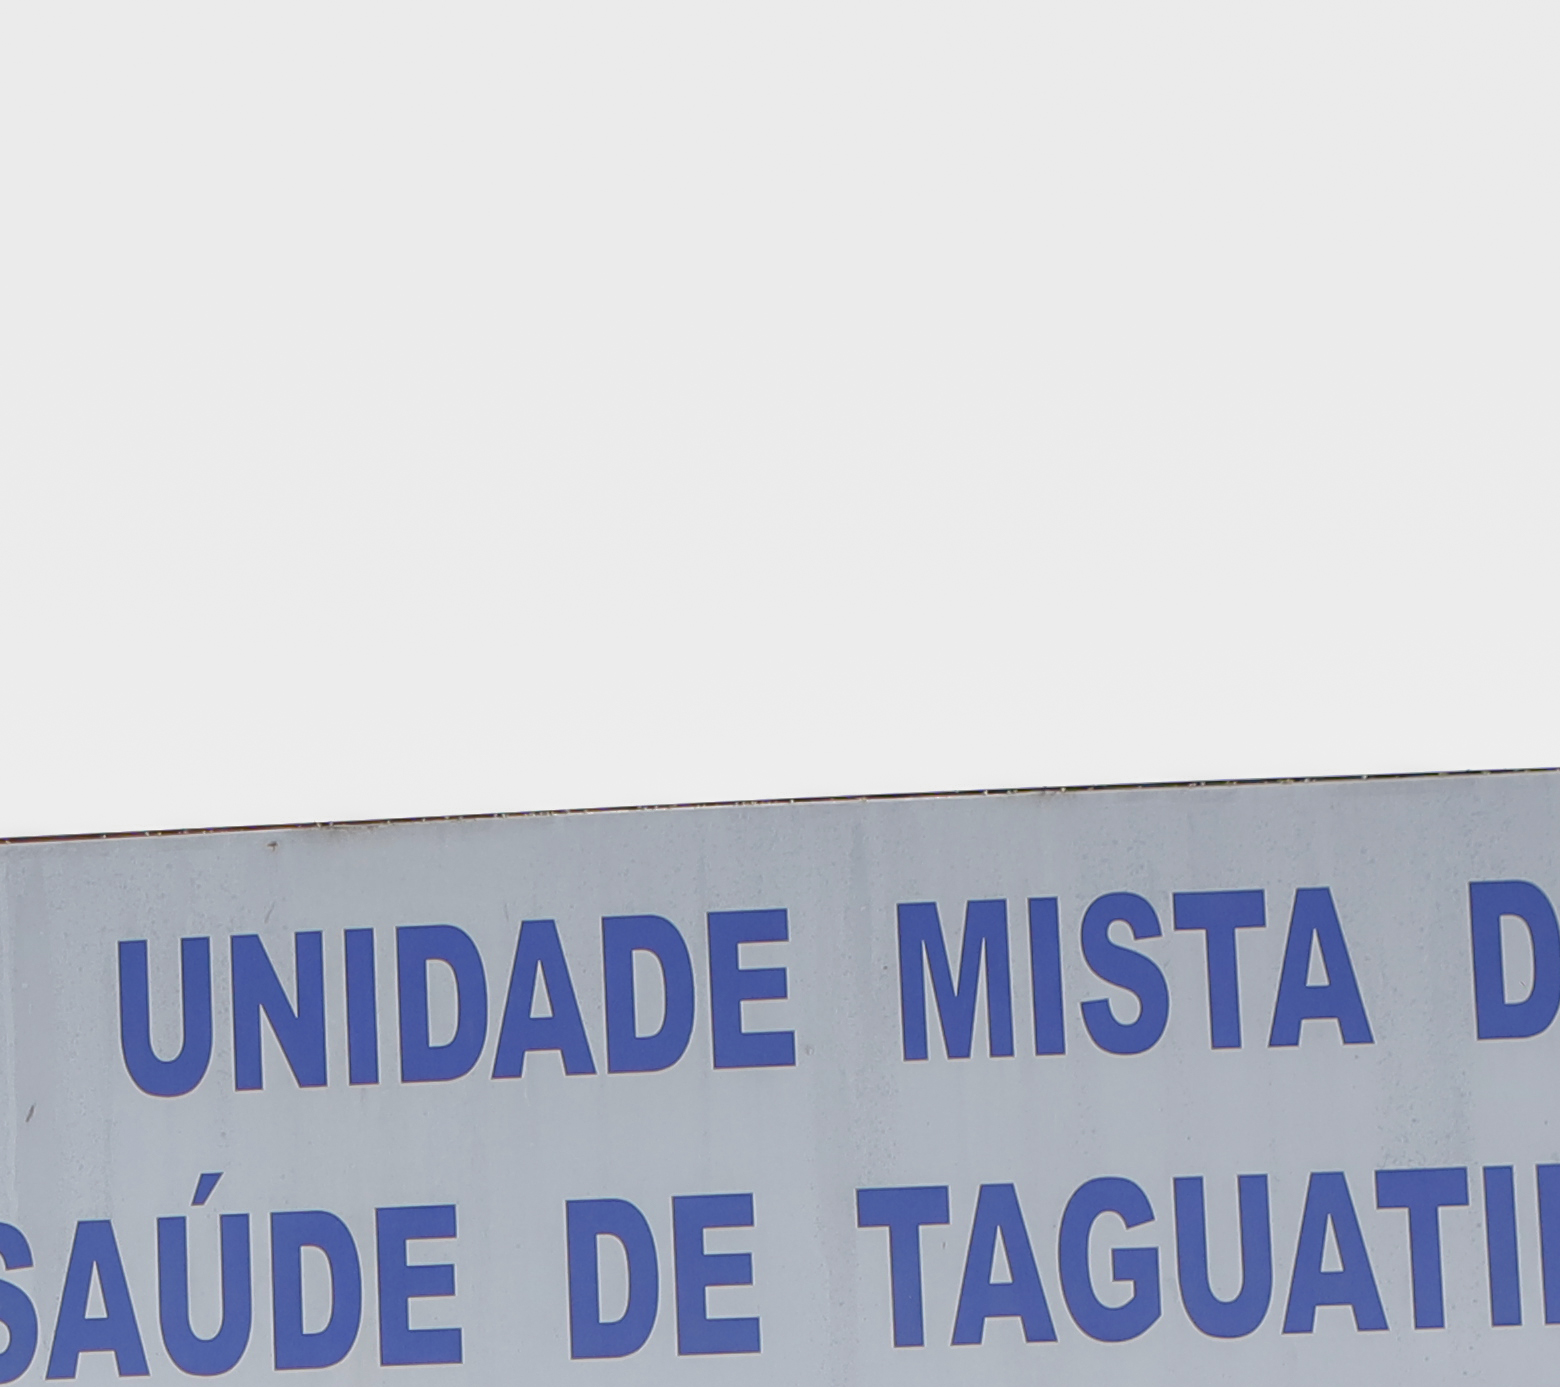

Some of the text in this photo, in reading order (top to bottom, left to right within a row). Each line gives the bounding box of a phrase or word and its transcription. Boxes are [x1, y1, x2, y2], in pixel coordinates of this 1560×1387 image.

[118, 907, 797, 1097] UNIDADE
[897, 887, 1375, 1061] MISTA
[566, 1190, 762, 1359] DE
